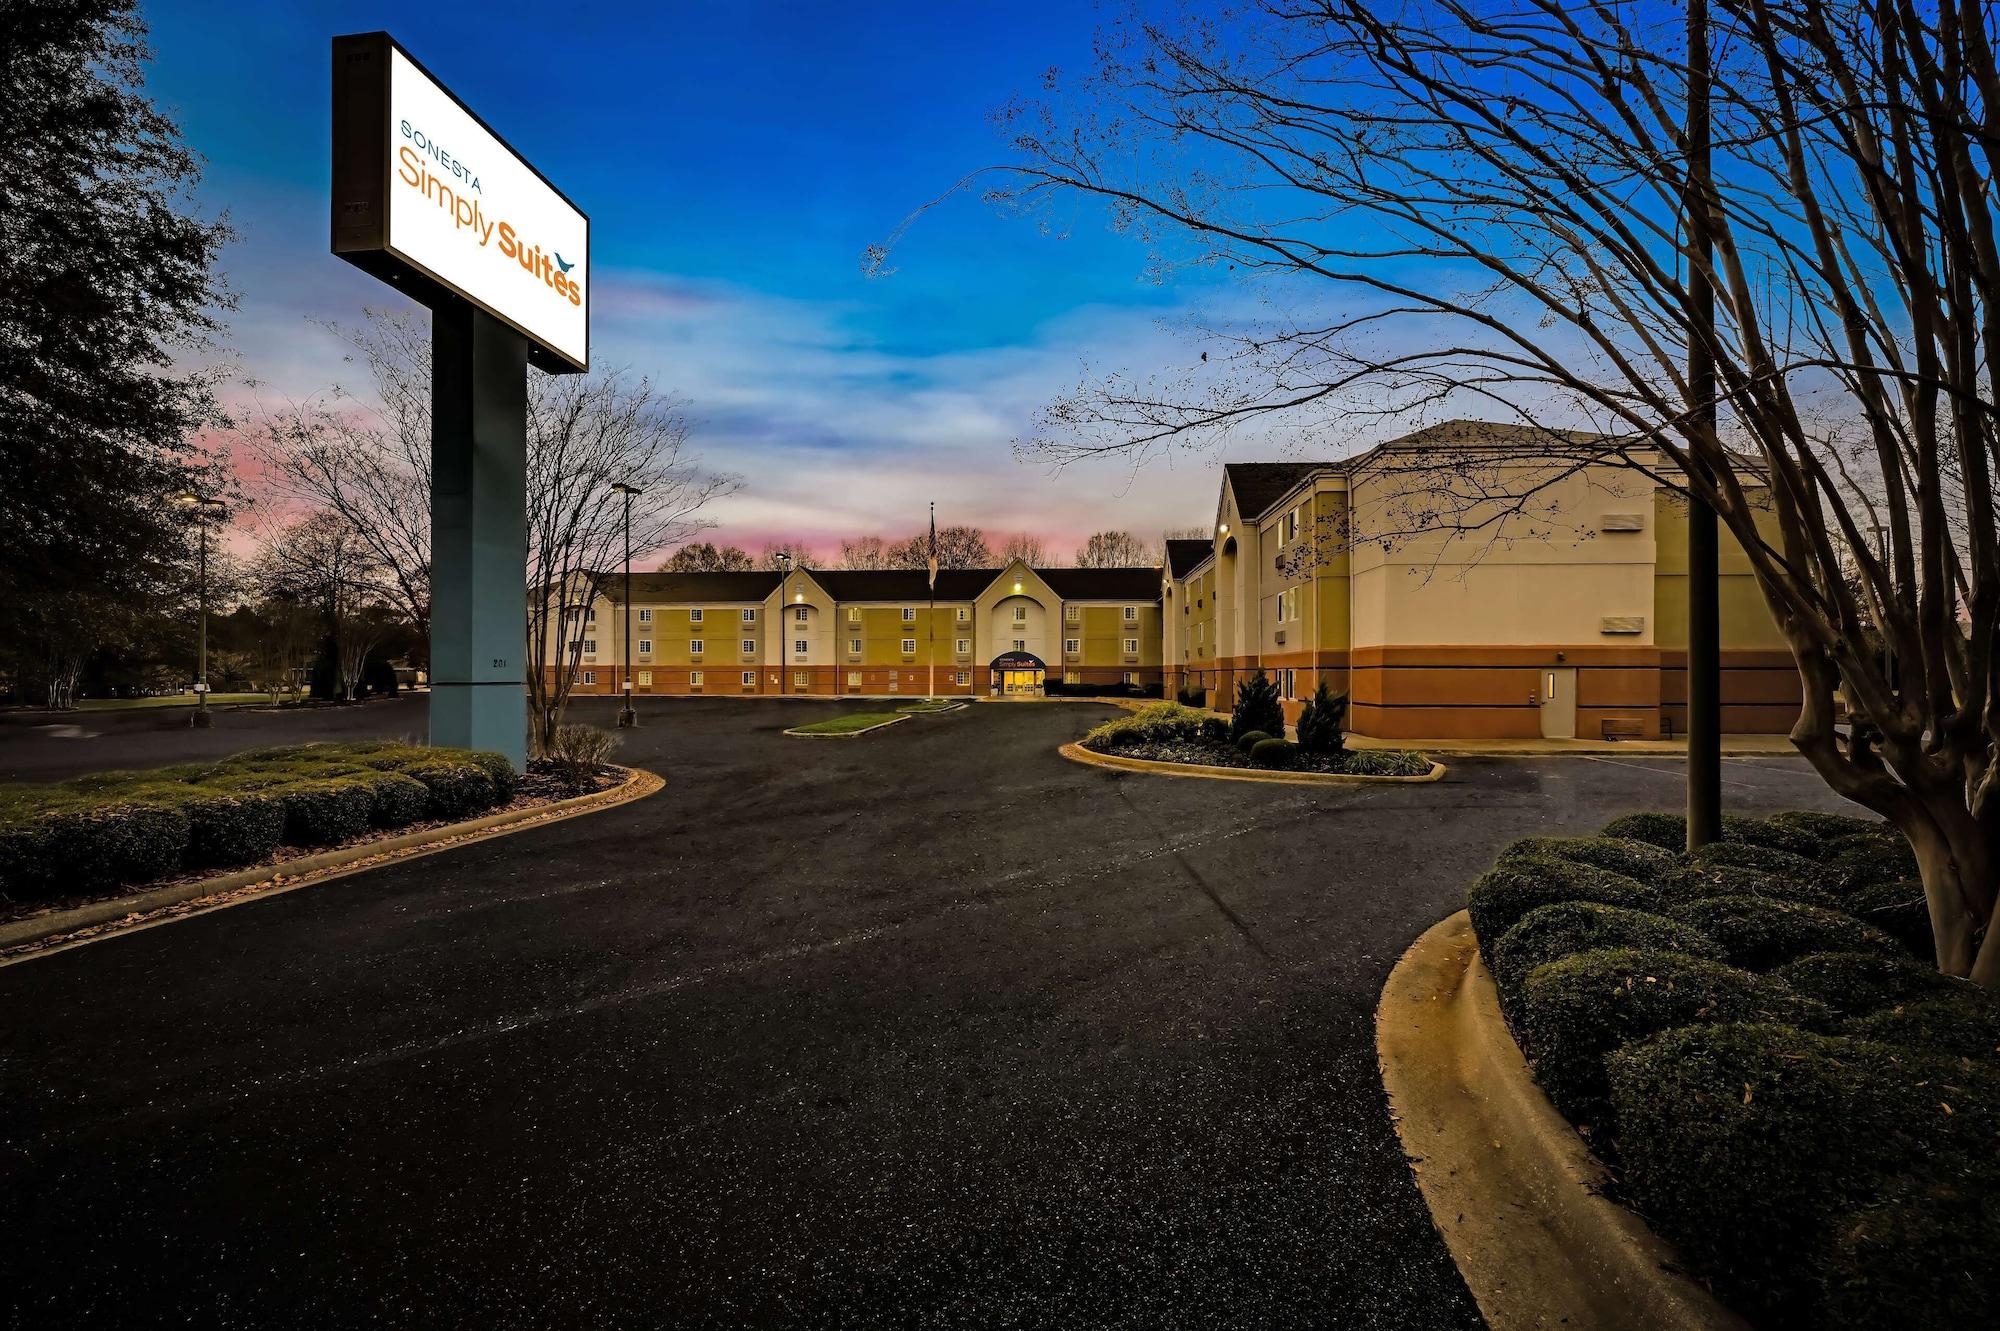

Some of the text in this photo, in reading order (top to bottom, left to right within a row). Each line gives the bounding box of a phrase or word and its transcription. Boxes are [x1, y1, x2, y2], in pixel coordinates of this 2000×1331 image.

[401, 119, 482, 195] SONESTA
[399, 146, 581, 307] Simply Suites
